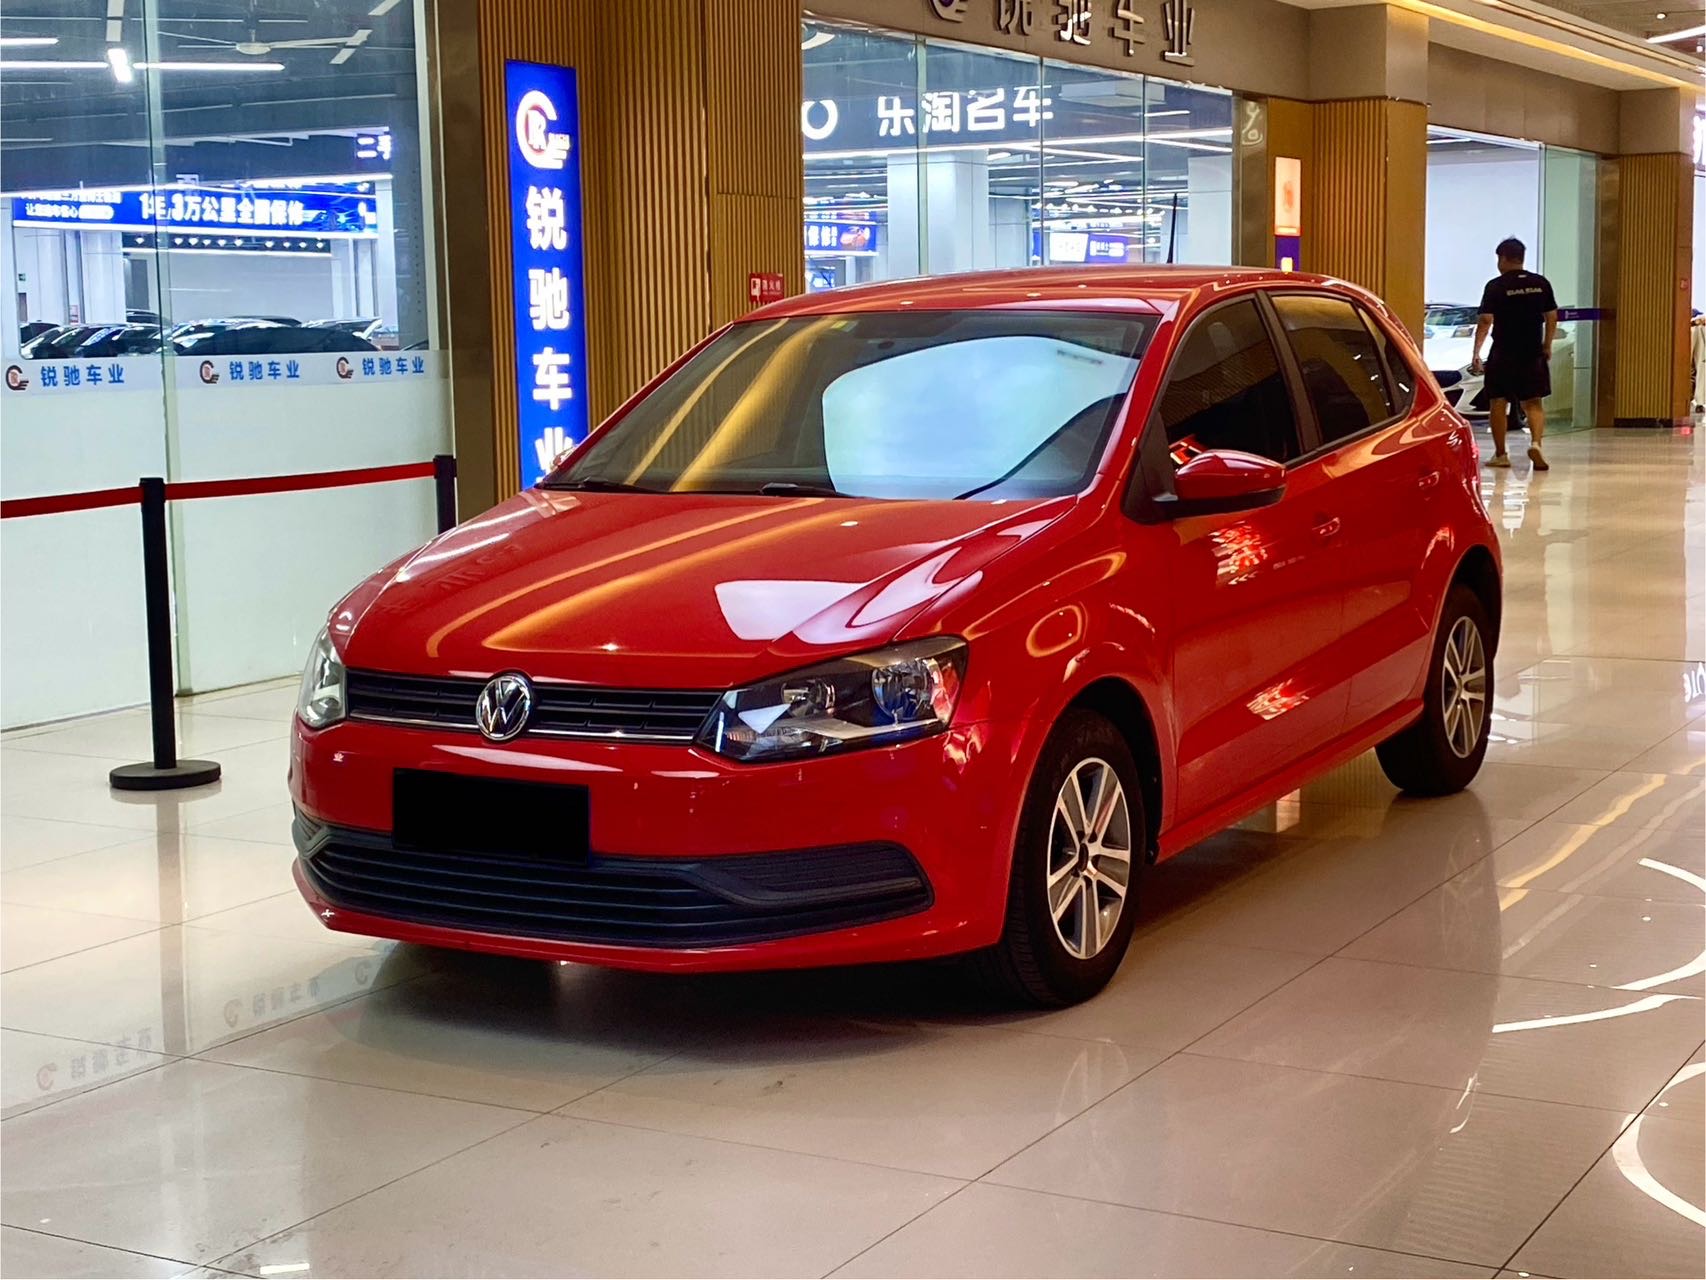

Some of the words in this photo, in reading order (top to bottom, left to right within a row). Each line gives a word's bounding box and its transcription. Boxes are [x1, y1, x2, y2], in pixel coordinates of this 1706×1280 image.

[877, 86, 1054, 137] 乐淘名车
[40, 363, 125, 387] 锐驰车业
[229, 360, 300, 381] 锐驰车业
[362, 356, 424, 376] 锐驰车业
